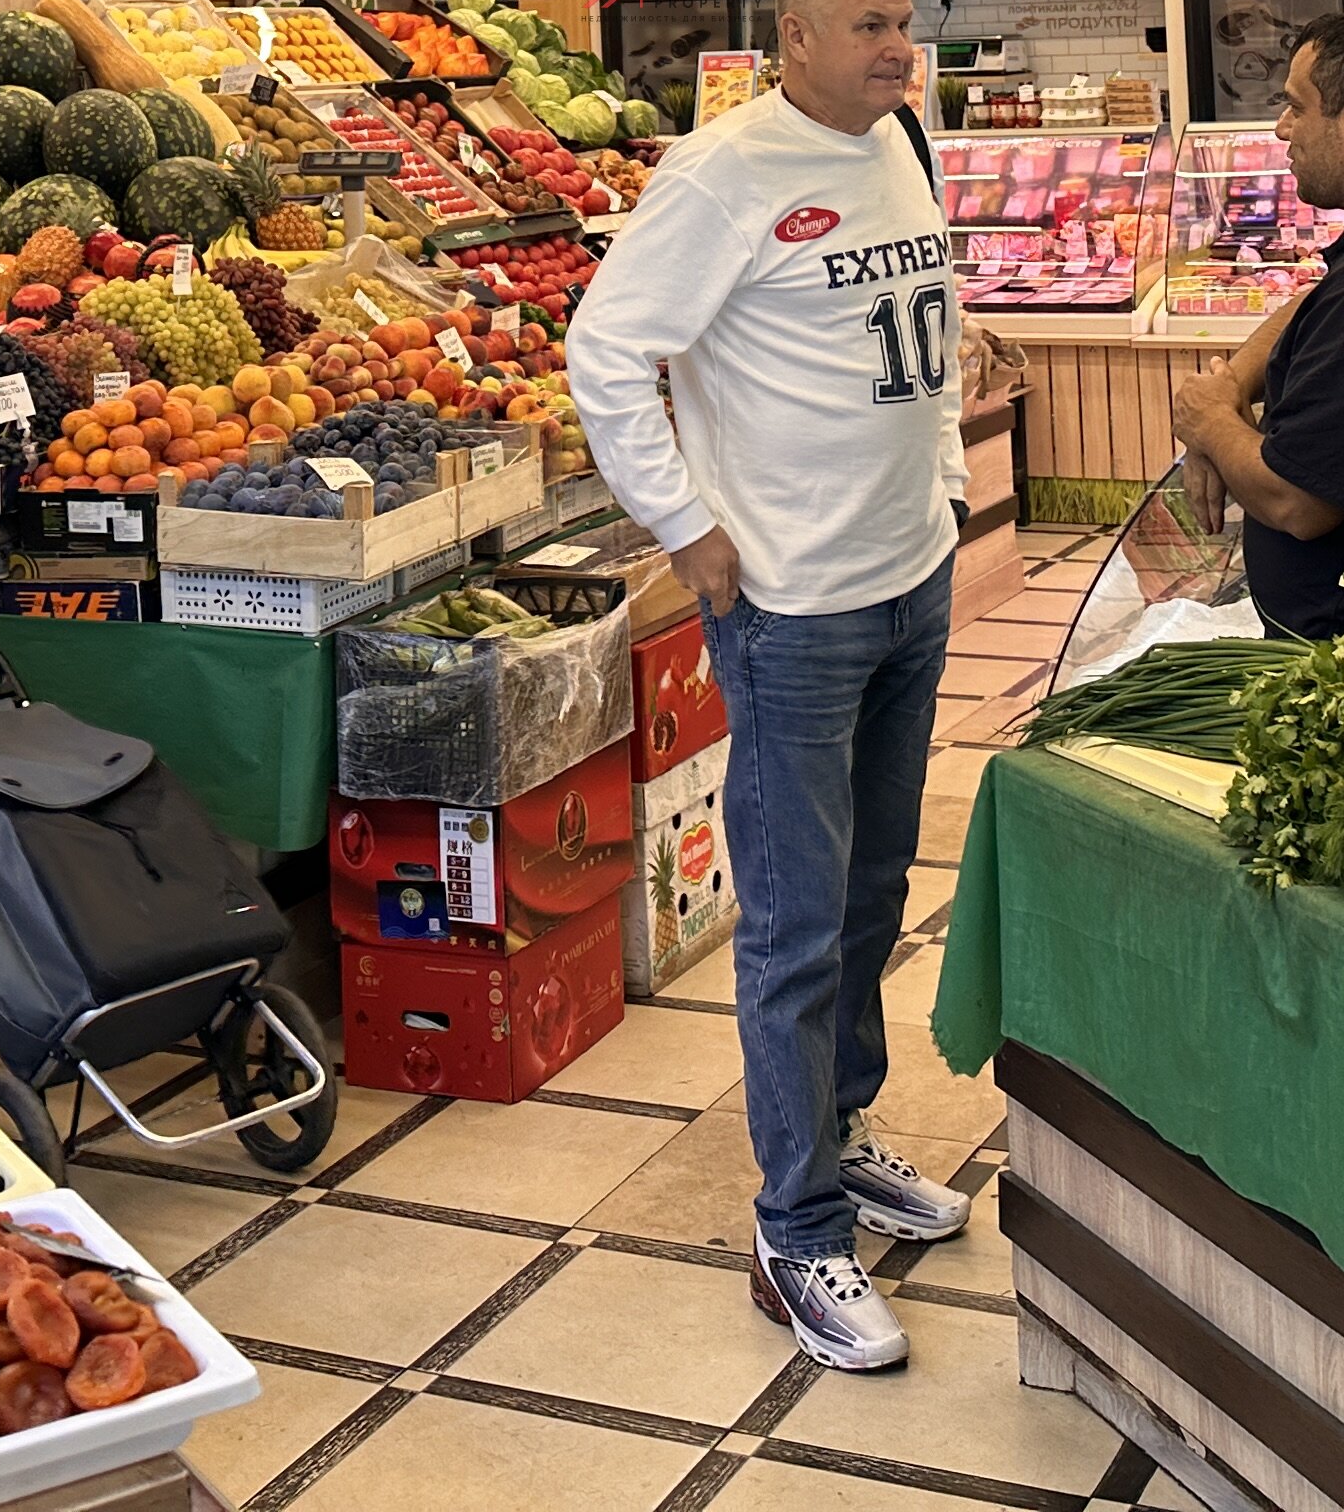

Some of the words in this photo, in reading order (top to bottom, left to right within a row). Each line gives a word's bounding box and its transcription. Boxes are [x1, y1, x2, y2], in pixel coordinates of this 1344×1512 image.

[1046, 16, 1138, 31] ПРОДУКТЫ
[786, 215, 831, 238] Champs
[866, 281, 947, 405] 10
[681, 896, 720, 938] PINEAPPLE
